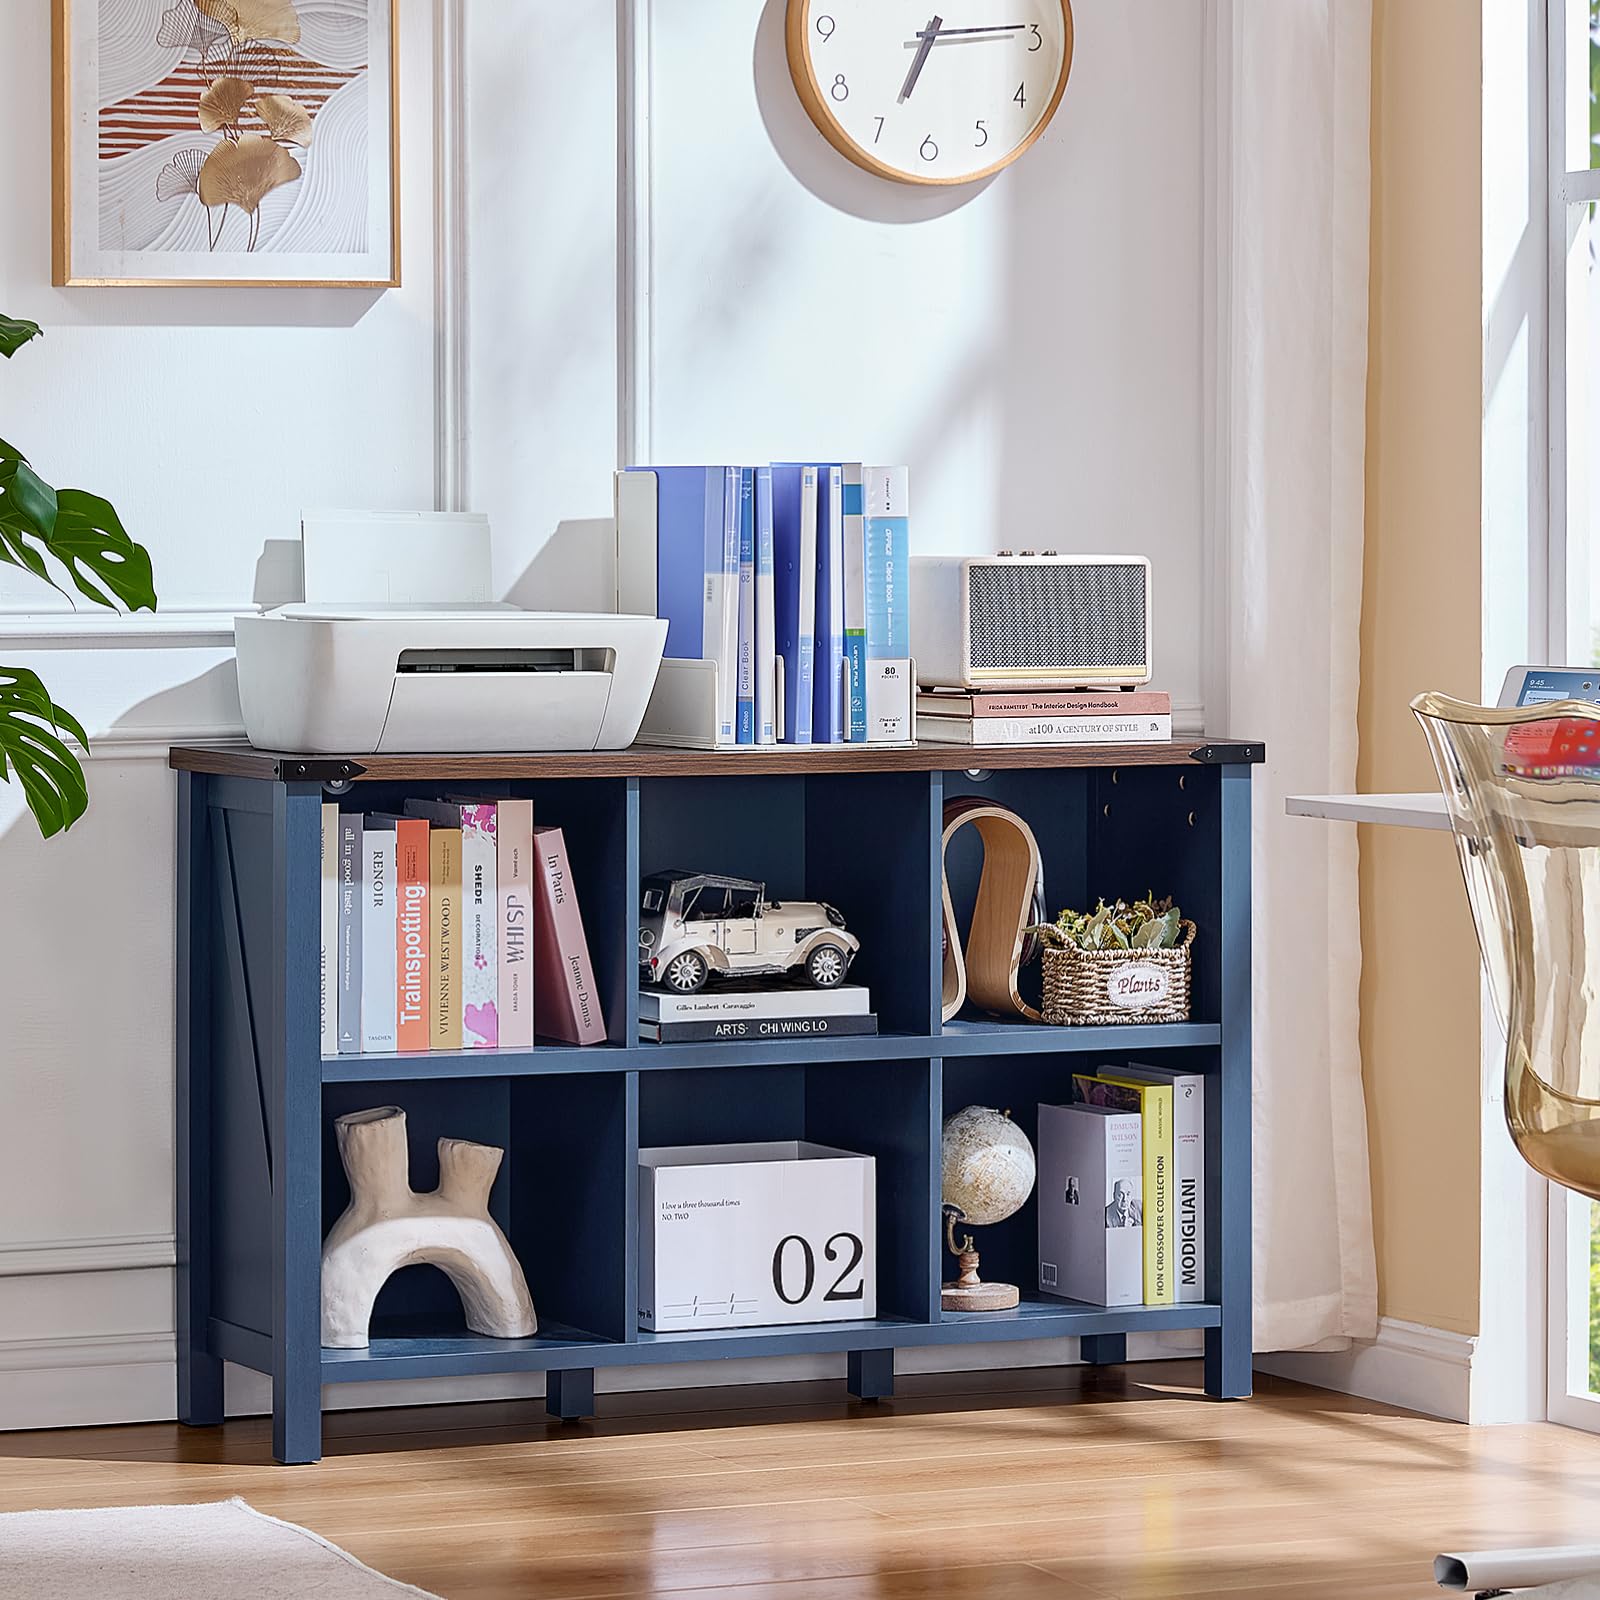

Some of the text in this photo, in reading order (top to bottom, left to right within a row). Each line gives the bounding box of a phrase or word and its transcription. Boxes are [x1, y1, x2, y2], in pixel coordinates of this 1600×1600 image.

[816, 15, 836, 43] 9
[1026, 24, 1043, 52] 3
[831, 74, 849, 101] 8
[1013, 81, 1027, 108] 4
[874, 116, 885, 144] 7
[974, 120, 988, 147] 5
[919, 134, 939, 161] 6
[886, 561, 894, 583] Clear
[886, 584, 894, 602] Book
[741, 669, 749, 690] Clear
[884, 666, 896, 675] 80
[1066, 702, 1088, 710] Design
[1088, 701, 1119, 709] Handbook
[1055, 726, 1062, 734] A
[1063, 725, 1101, 734] CENTURY
[1102, 724, 1113, 732] OF
[1114, 723, 1139, 732] STYLE
[342, 827, 355, 915] all in good taste
[373, 851, 384, 908] RENOIR
[474, 864, 483, 905] SHEDE
[440, 897, 450, 972] WESTWOOD
[547, 854, 593, 1029] In Paris Jeanne Damas
[1117, 975, 1161, 996] Plants
[439, 975, 450, 1035] VIVIENNE
[694, 1003, 719, 1011] Lambert
[722, 1001, 756, 1010] Caravaggio
[760, 1022, 778, 1034] CHI
[781, 1021, 810, 1033] WING
[812, 1020, 828, 1031] LO
[1110, 1122, 1139, 1131] EDMUND
[1111, 1133, 1138, 1141] WILSON
[665, 1201, 676, 1209] love
[682, 1200, 697, 1208] three
[698, 1199, 725, 1208] thousand
[674, 1212, 689, 1220] TWO
[1157, 1155, 1165, 1297] FION CROSSOVER COLLECTION
[1181, 1178, 1196, 1285] MODIGLIANI
[772, 1232, 864, 1305] 02
